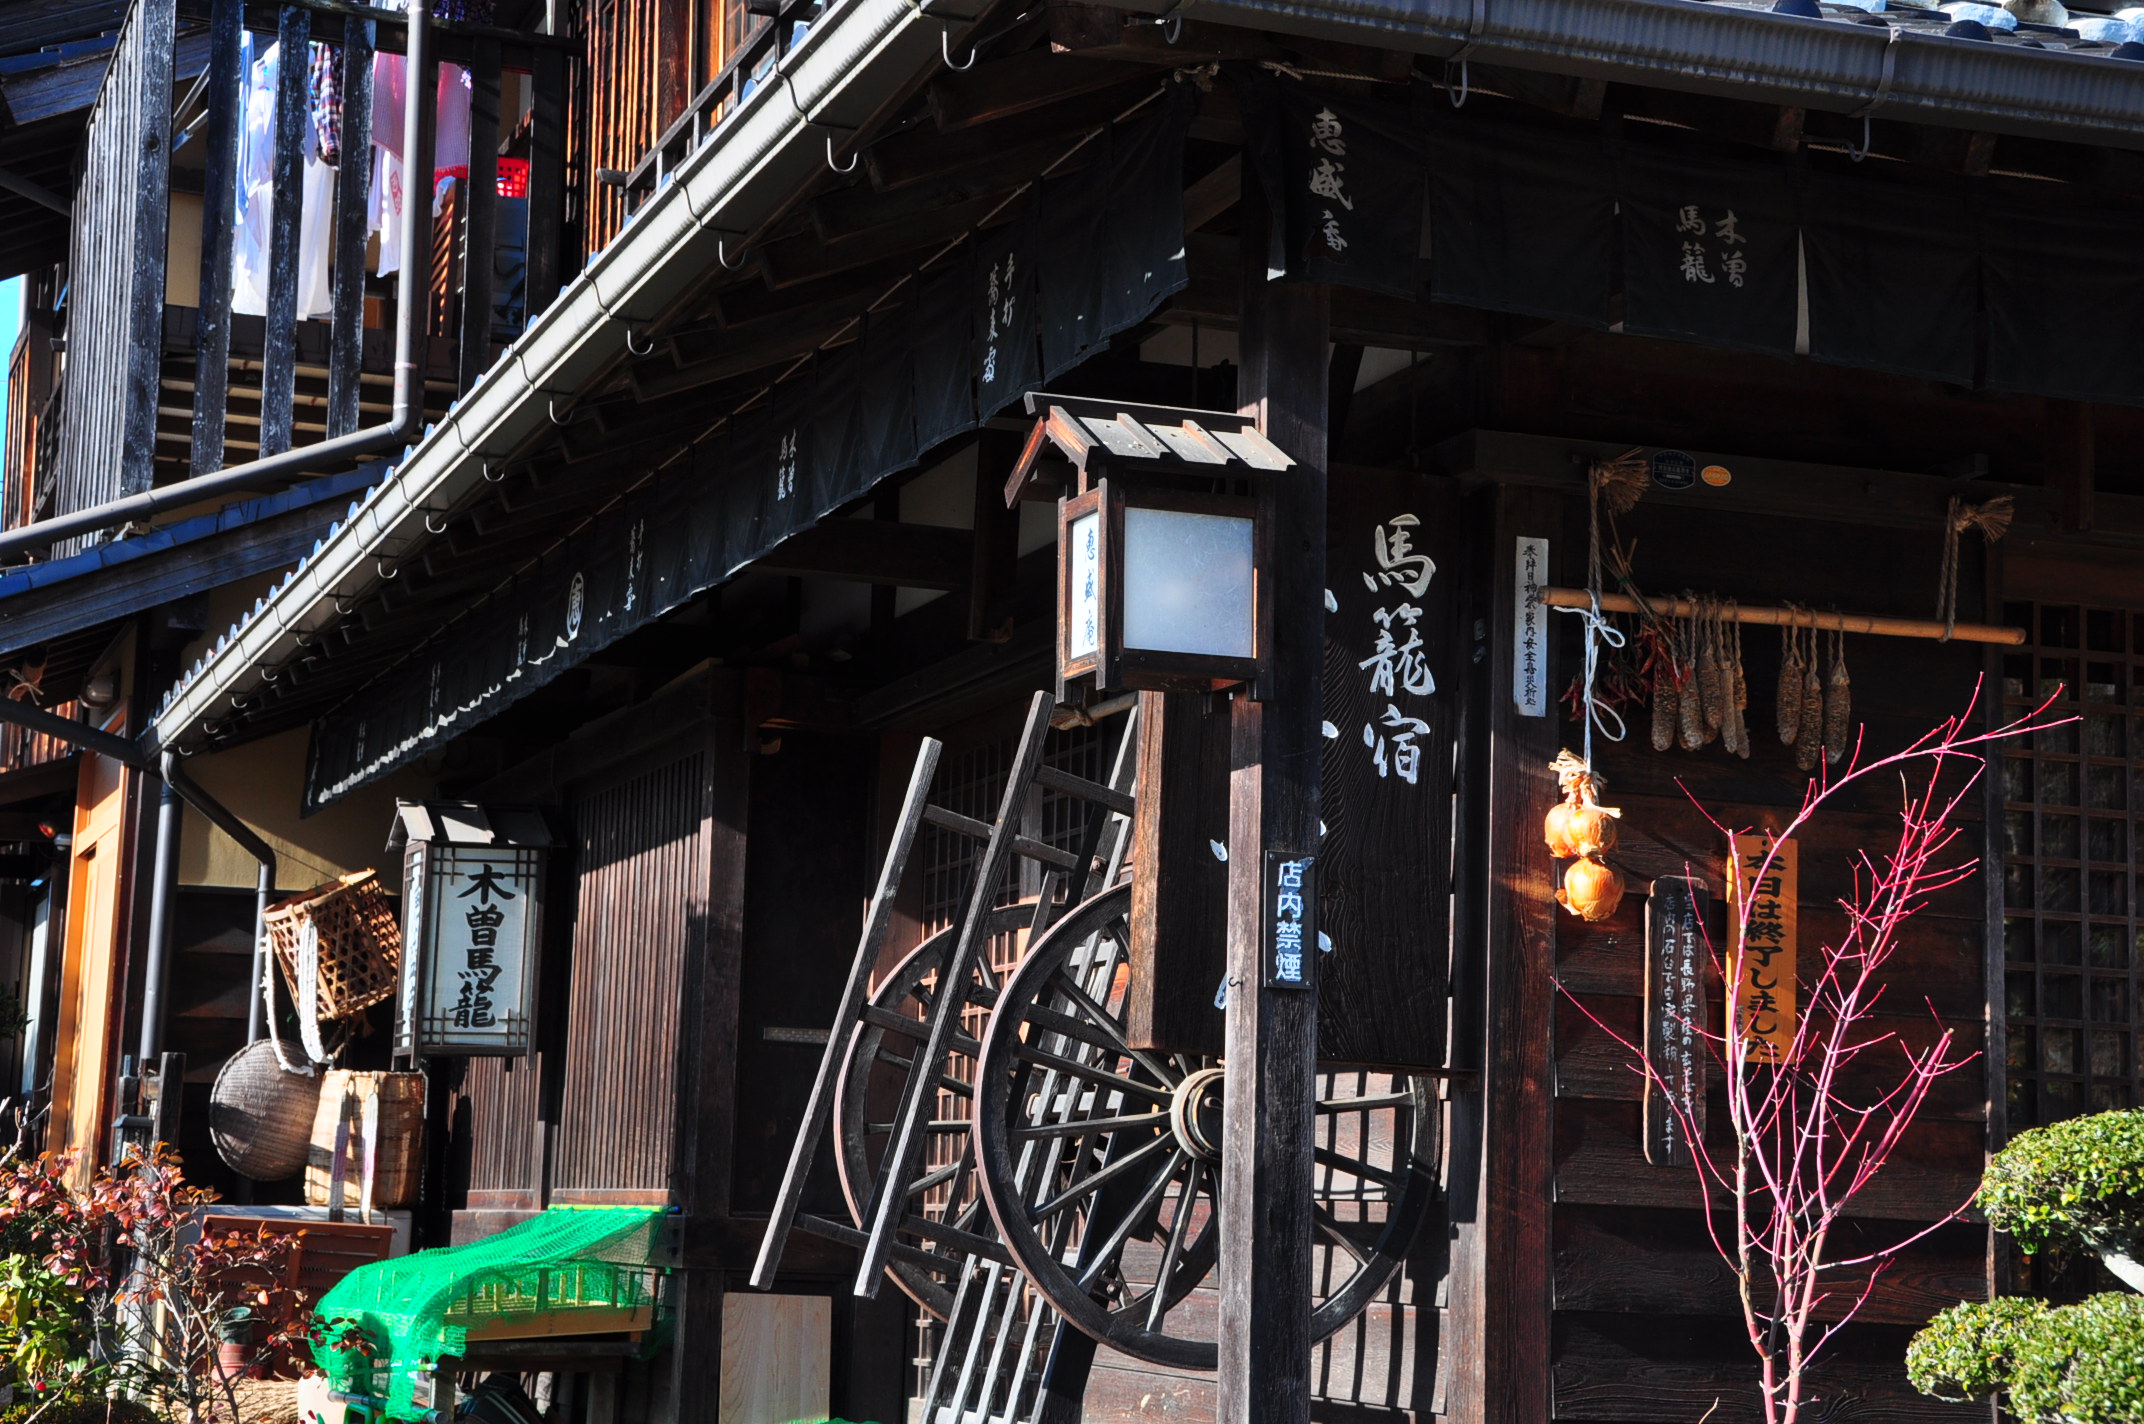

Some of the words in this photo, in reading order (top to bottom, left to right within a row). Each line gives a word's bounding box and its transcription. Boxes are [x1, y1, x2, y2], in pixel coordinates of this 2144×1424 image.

[1675, 205, 1716, 284] 馬籠
[1358, 513, 1437, 785] 馬籠宿
[448, 863, 516, 1028] 木曽馬籠
[1275, 860, 1304, 982] 店内禁煙
[1743, 850, 1787, 1058] 本日は終了しました
